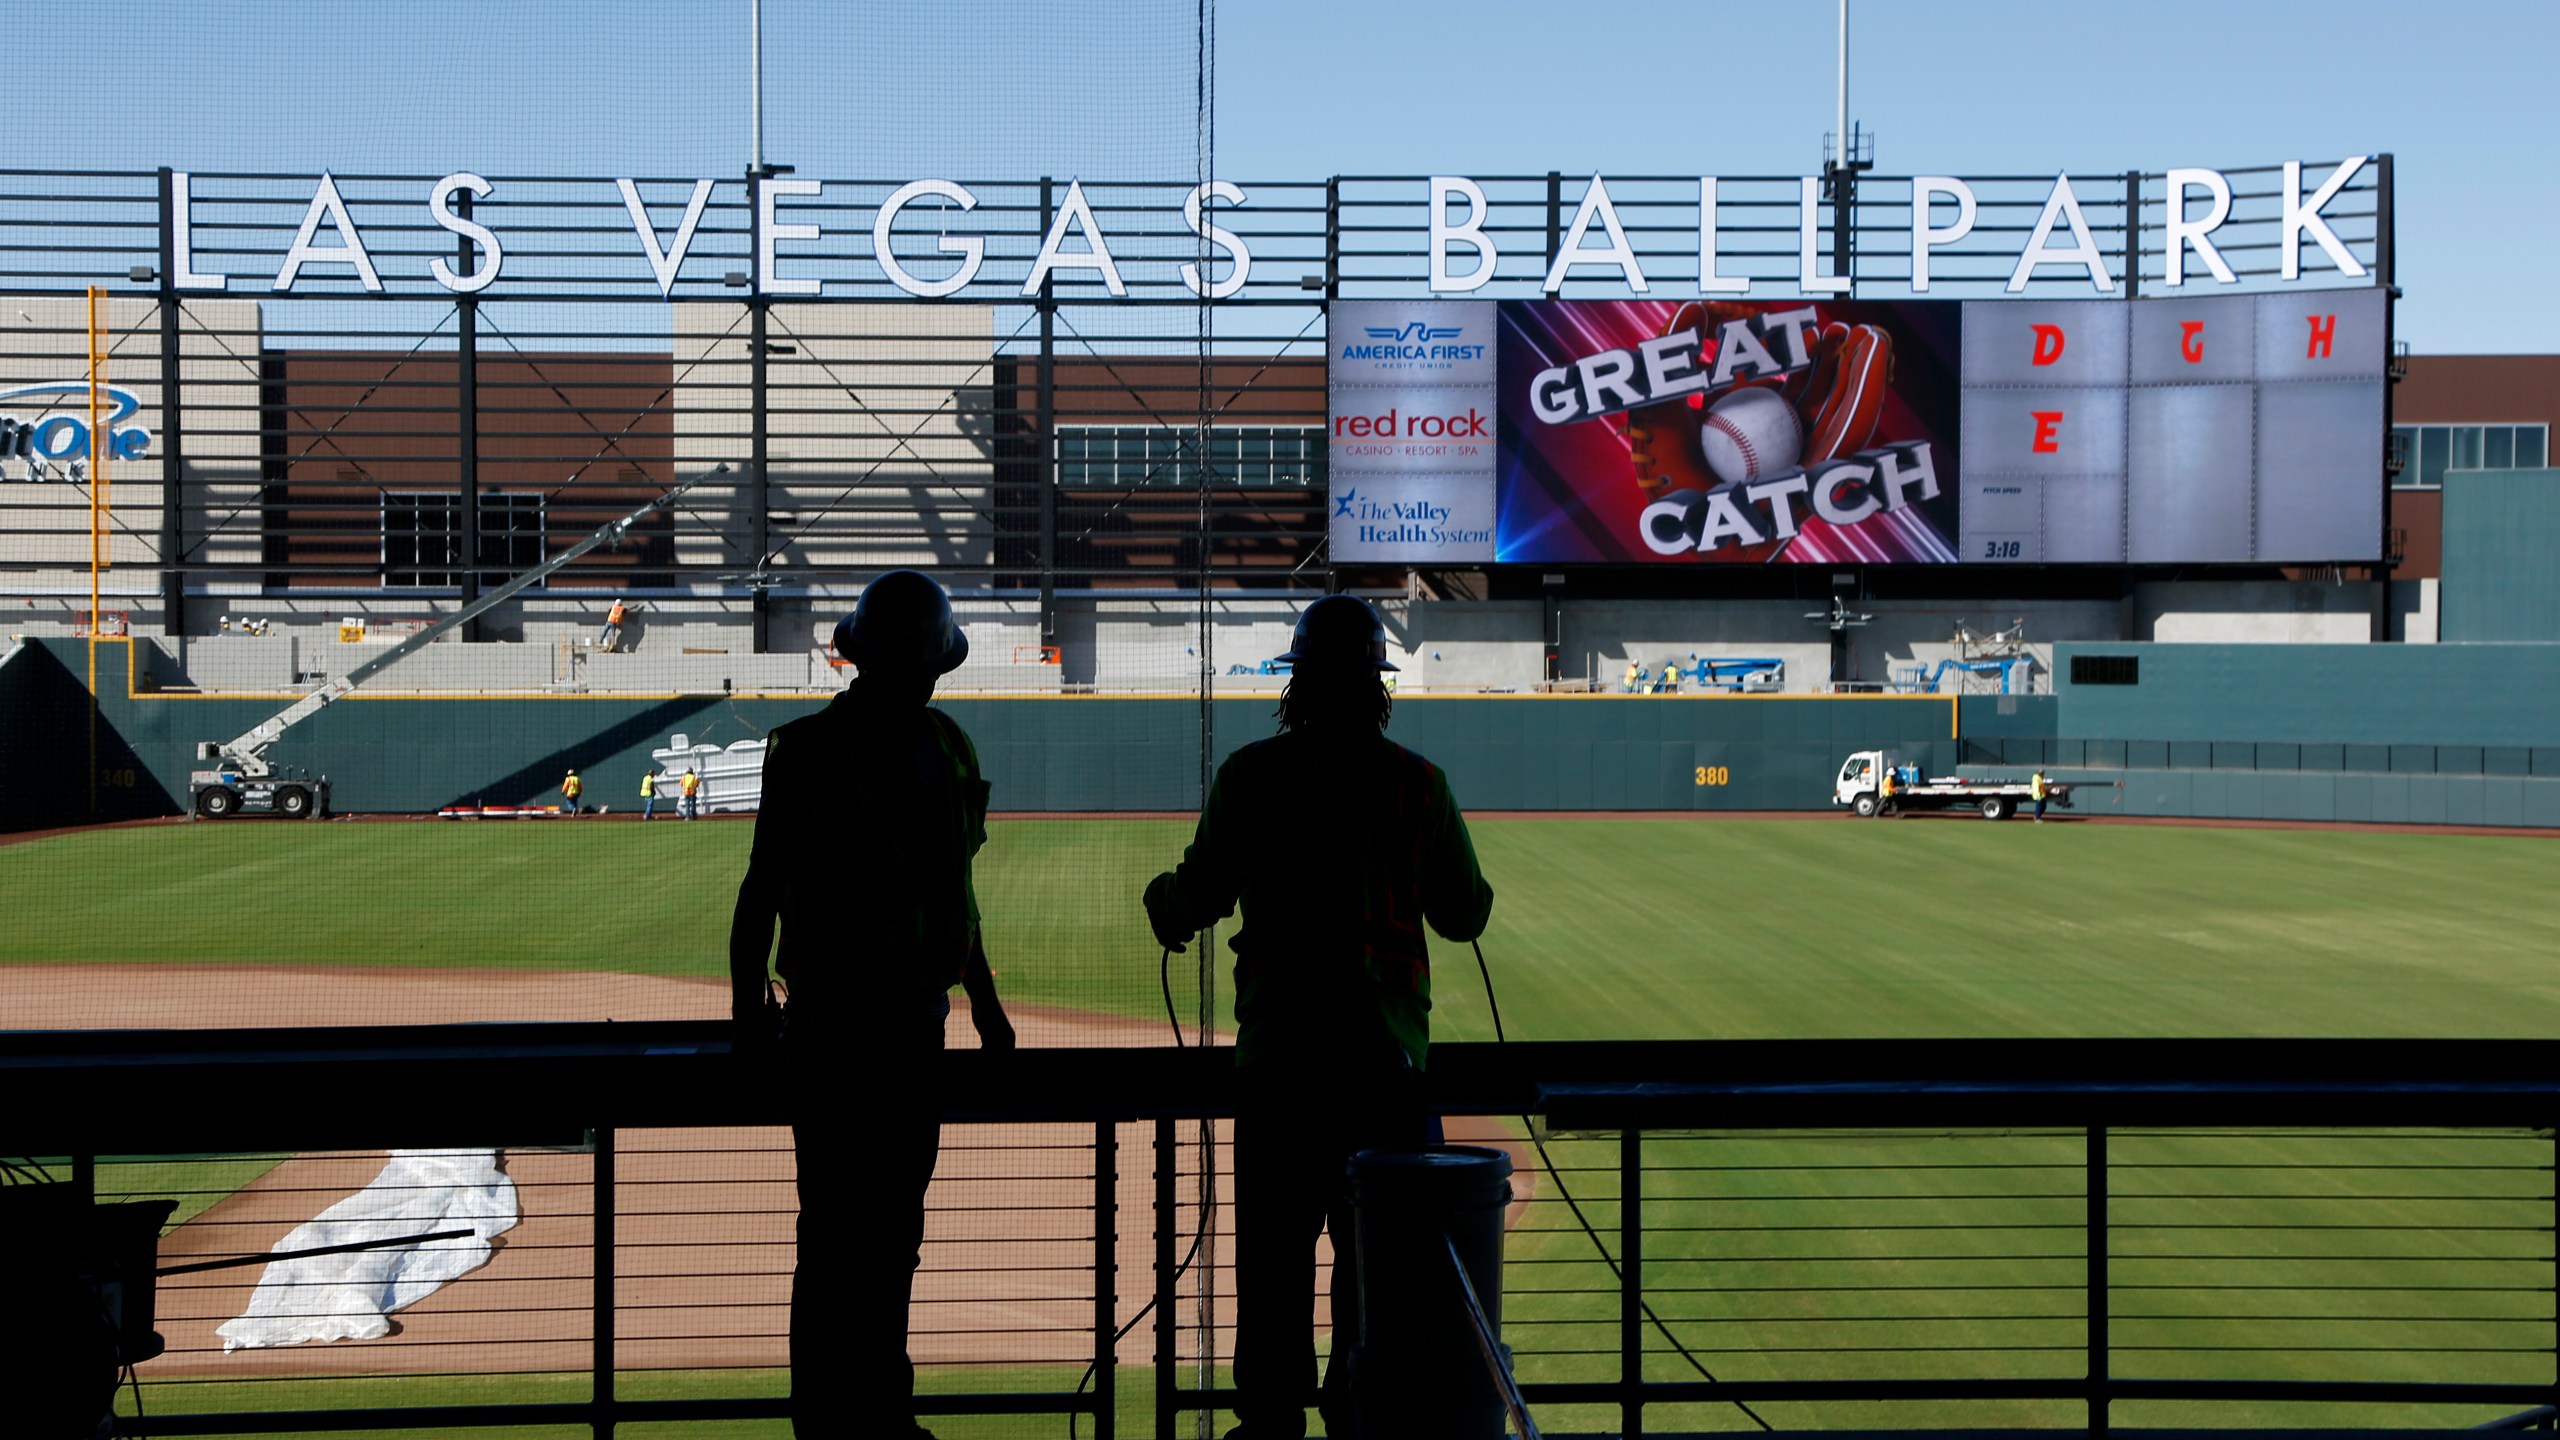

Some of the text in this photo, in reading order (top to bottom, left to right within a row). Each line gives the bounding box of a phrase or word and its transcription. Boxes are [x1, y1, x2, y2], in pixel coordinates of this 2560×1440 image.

[171, 155, 2374, 300] LAS VEGAS BALLPARK
[2029, 323, 2066, 367] D
[2179, 320, 2206, 364] G
[2306, 314, 2337, 359] H
[1342, 345, 1485, 360] AMERICA FIRST
[1530, 305, 1819, 425] GREAT
[1335, 408, 1489, 437] red rock
[2029, 411, 2064, 453] E
[1345, 445, 1479, 456] CASINO RESORT SPA
[1639, 441, 1941, 555] CATCH
[1358, 501, 1451, 525] The Valley
[1359, 523, 1490, 548] Health System
[1984, 541, 2021, 558] 3:18
[101, 768, 136, 788] 340
[1695, 765, 1729, 786] 380
